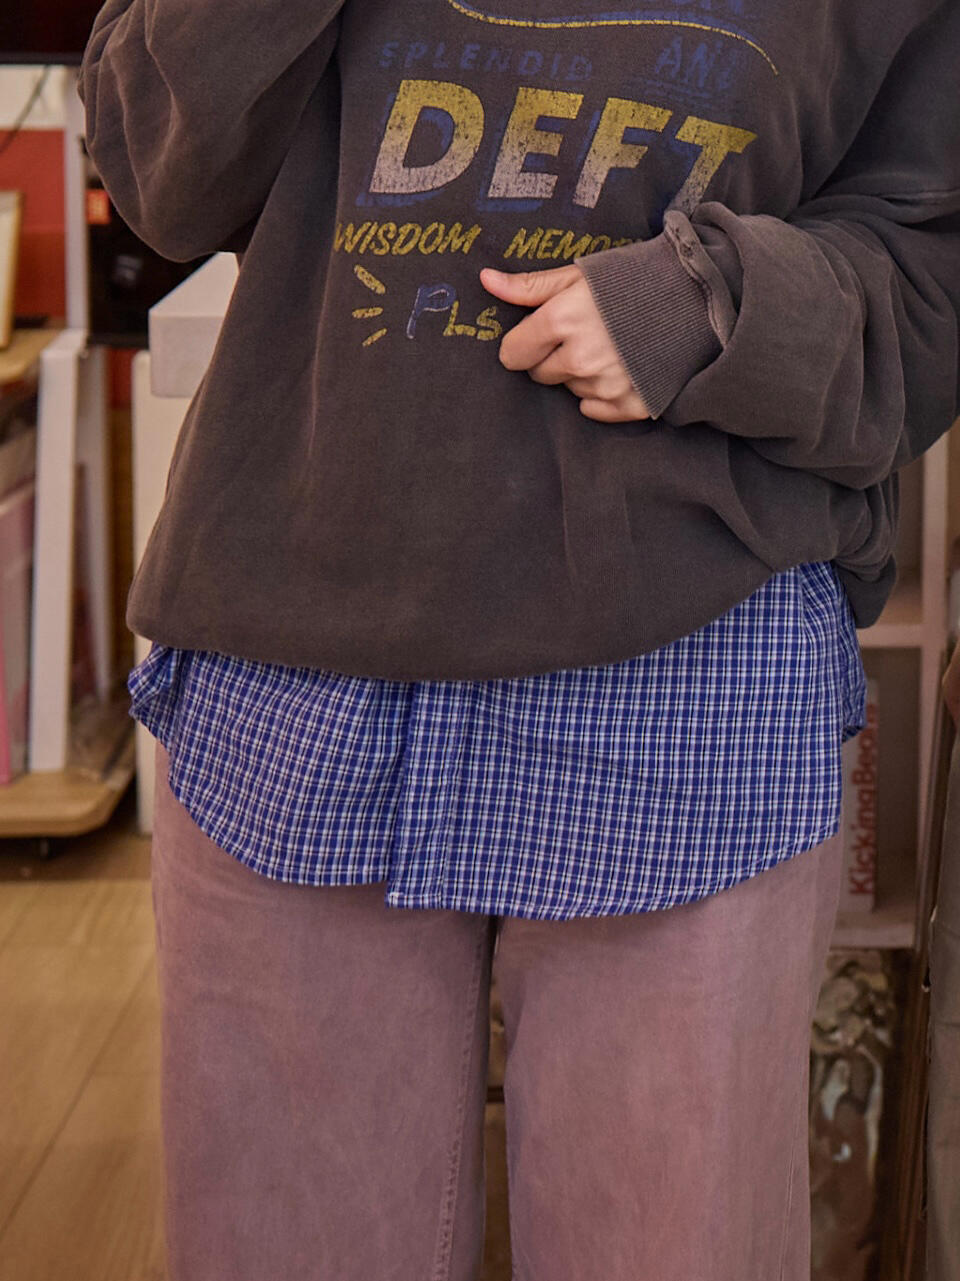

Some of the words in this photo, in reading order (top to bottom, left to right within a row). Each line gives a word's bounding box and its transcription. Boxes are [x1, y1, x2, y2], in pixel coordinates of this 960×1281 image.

[378, 39, 594, 81] SPLENDID
[366, 78, 759, 218] DEFT
[334, 221, 482, 257] WISDOM
[503, 227, 644, 261] MEMO
